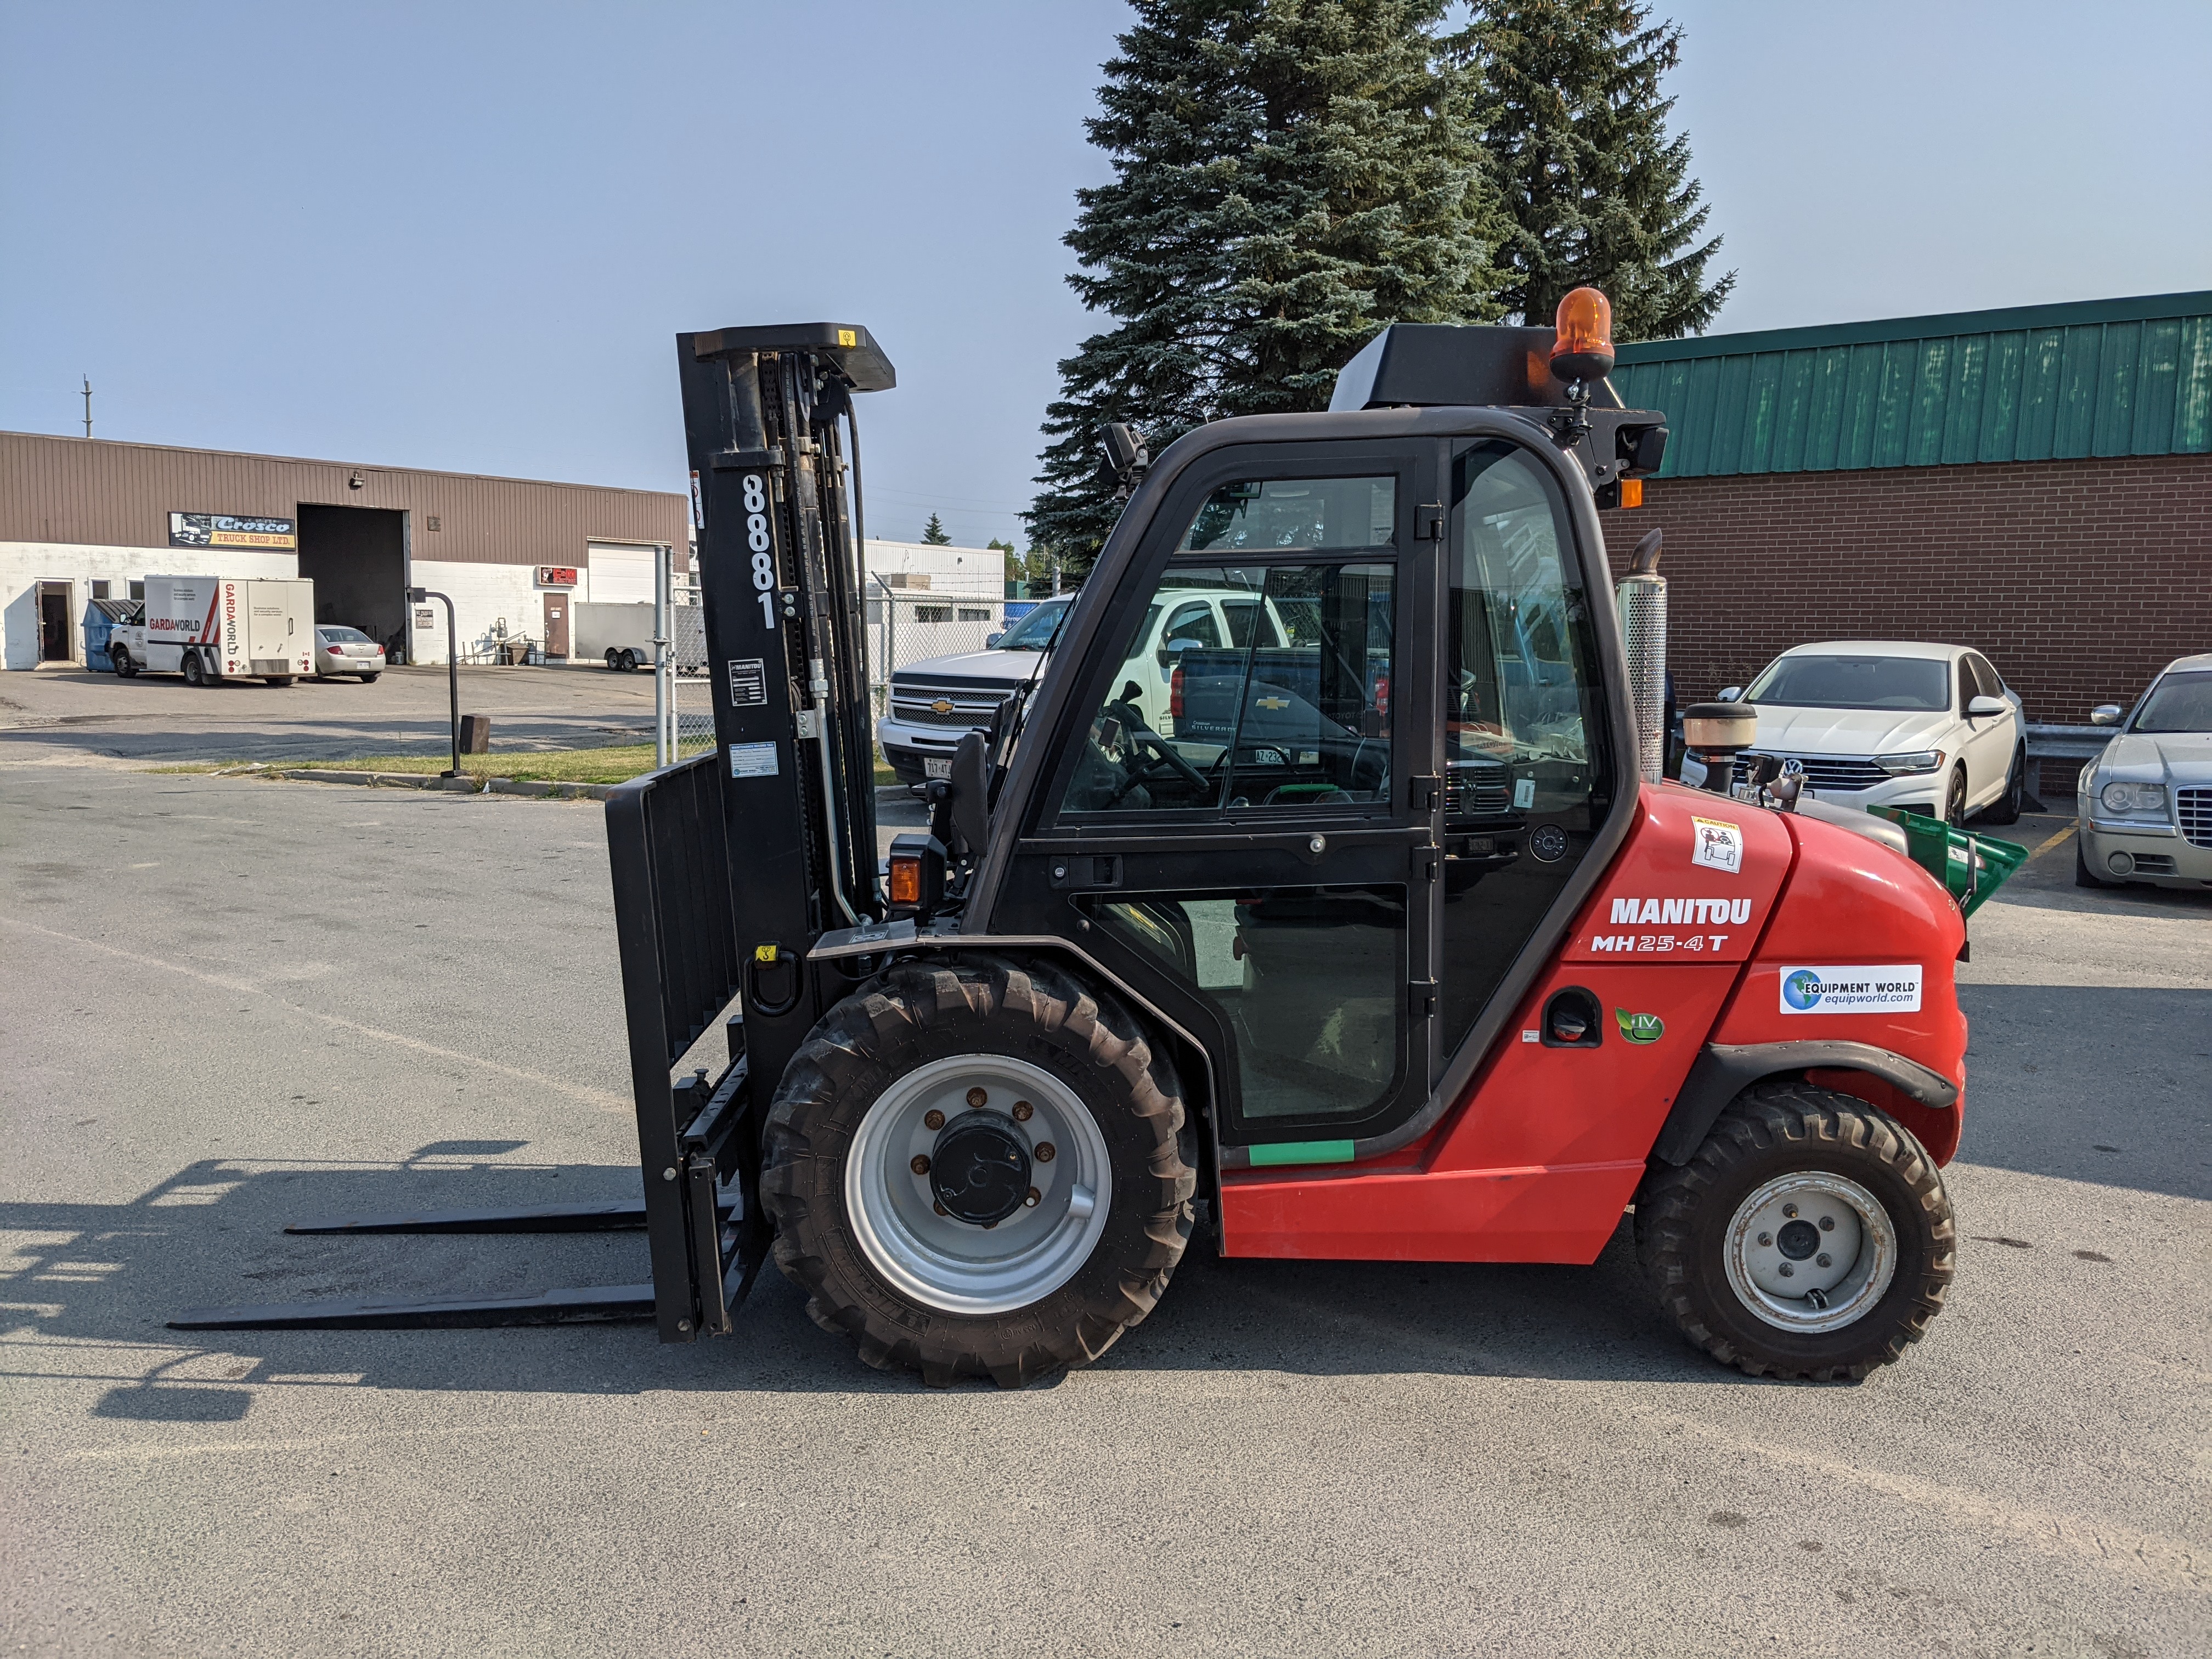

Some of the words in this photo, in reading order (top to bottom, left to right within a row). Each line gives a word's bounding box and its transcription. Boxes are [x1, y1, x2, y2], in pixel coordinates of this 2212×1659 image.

[217, 517, 290, 532] Crosco
[217, 533, 247, 543] TRUCK
[249, 535, 270, 544] SHOP
[272, 537, 290, 545] LTD.
[150, 618, 200, 632] GARDAWORLD
[225, 584, 236, 655] GARDAWORLD
[1256, 751, 1265, 761] AZ
[1705, 820, 1735, 829] CAUTION
[1610, 898, 1751, 924] MANITOU
[1805, 983, 1870, 995] EQUIPMENT
[1825, 993, 1913, 1005] equipworld.com
[1638, 1016, 1657, 1028] IV
